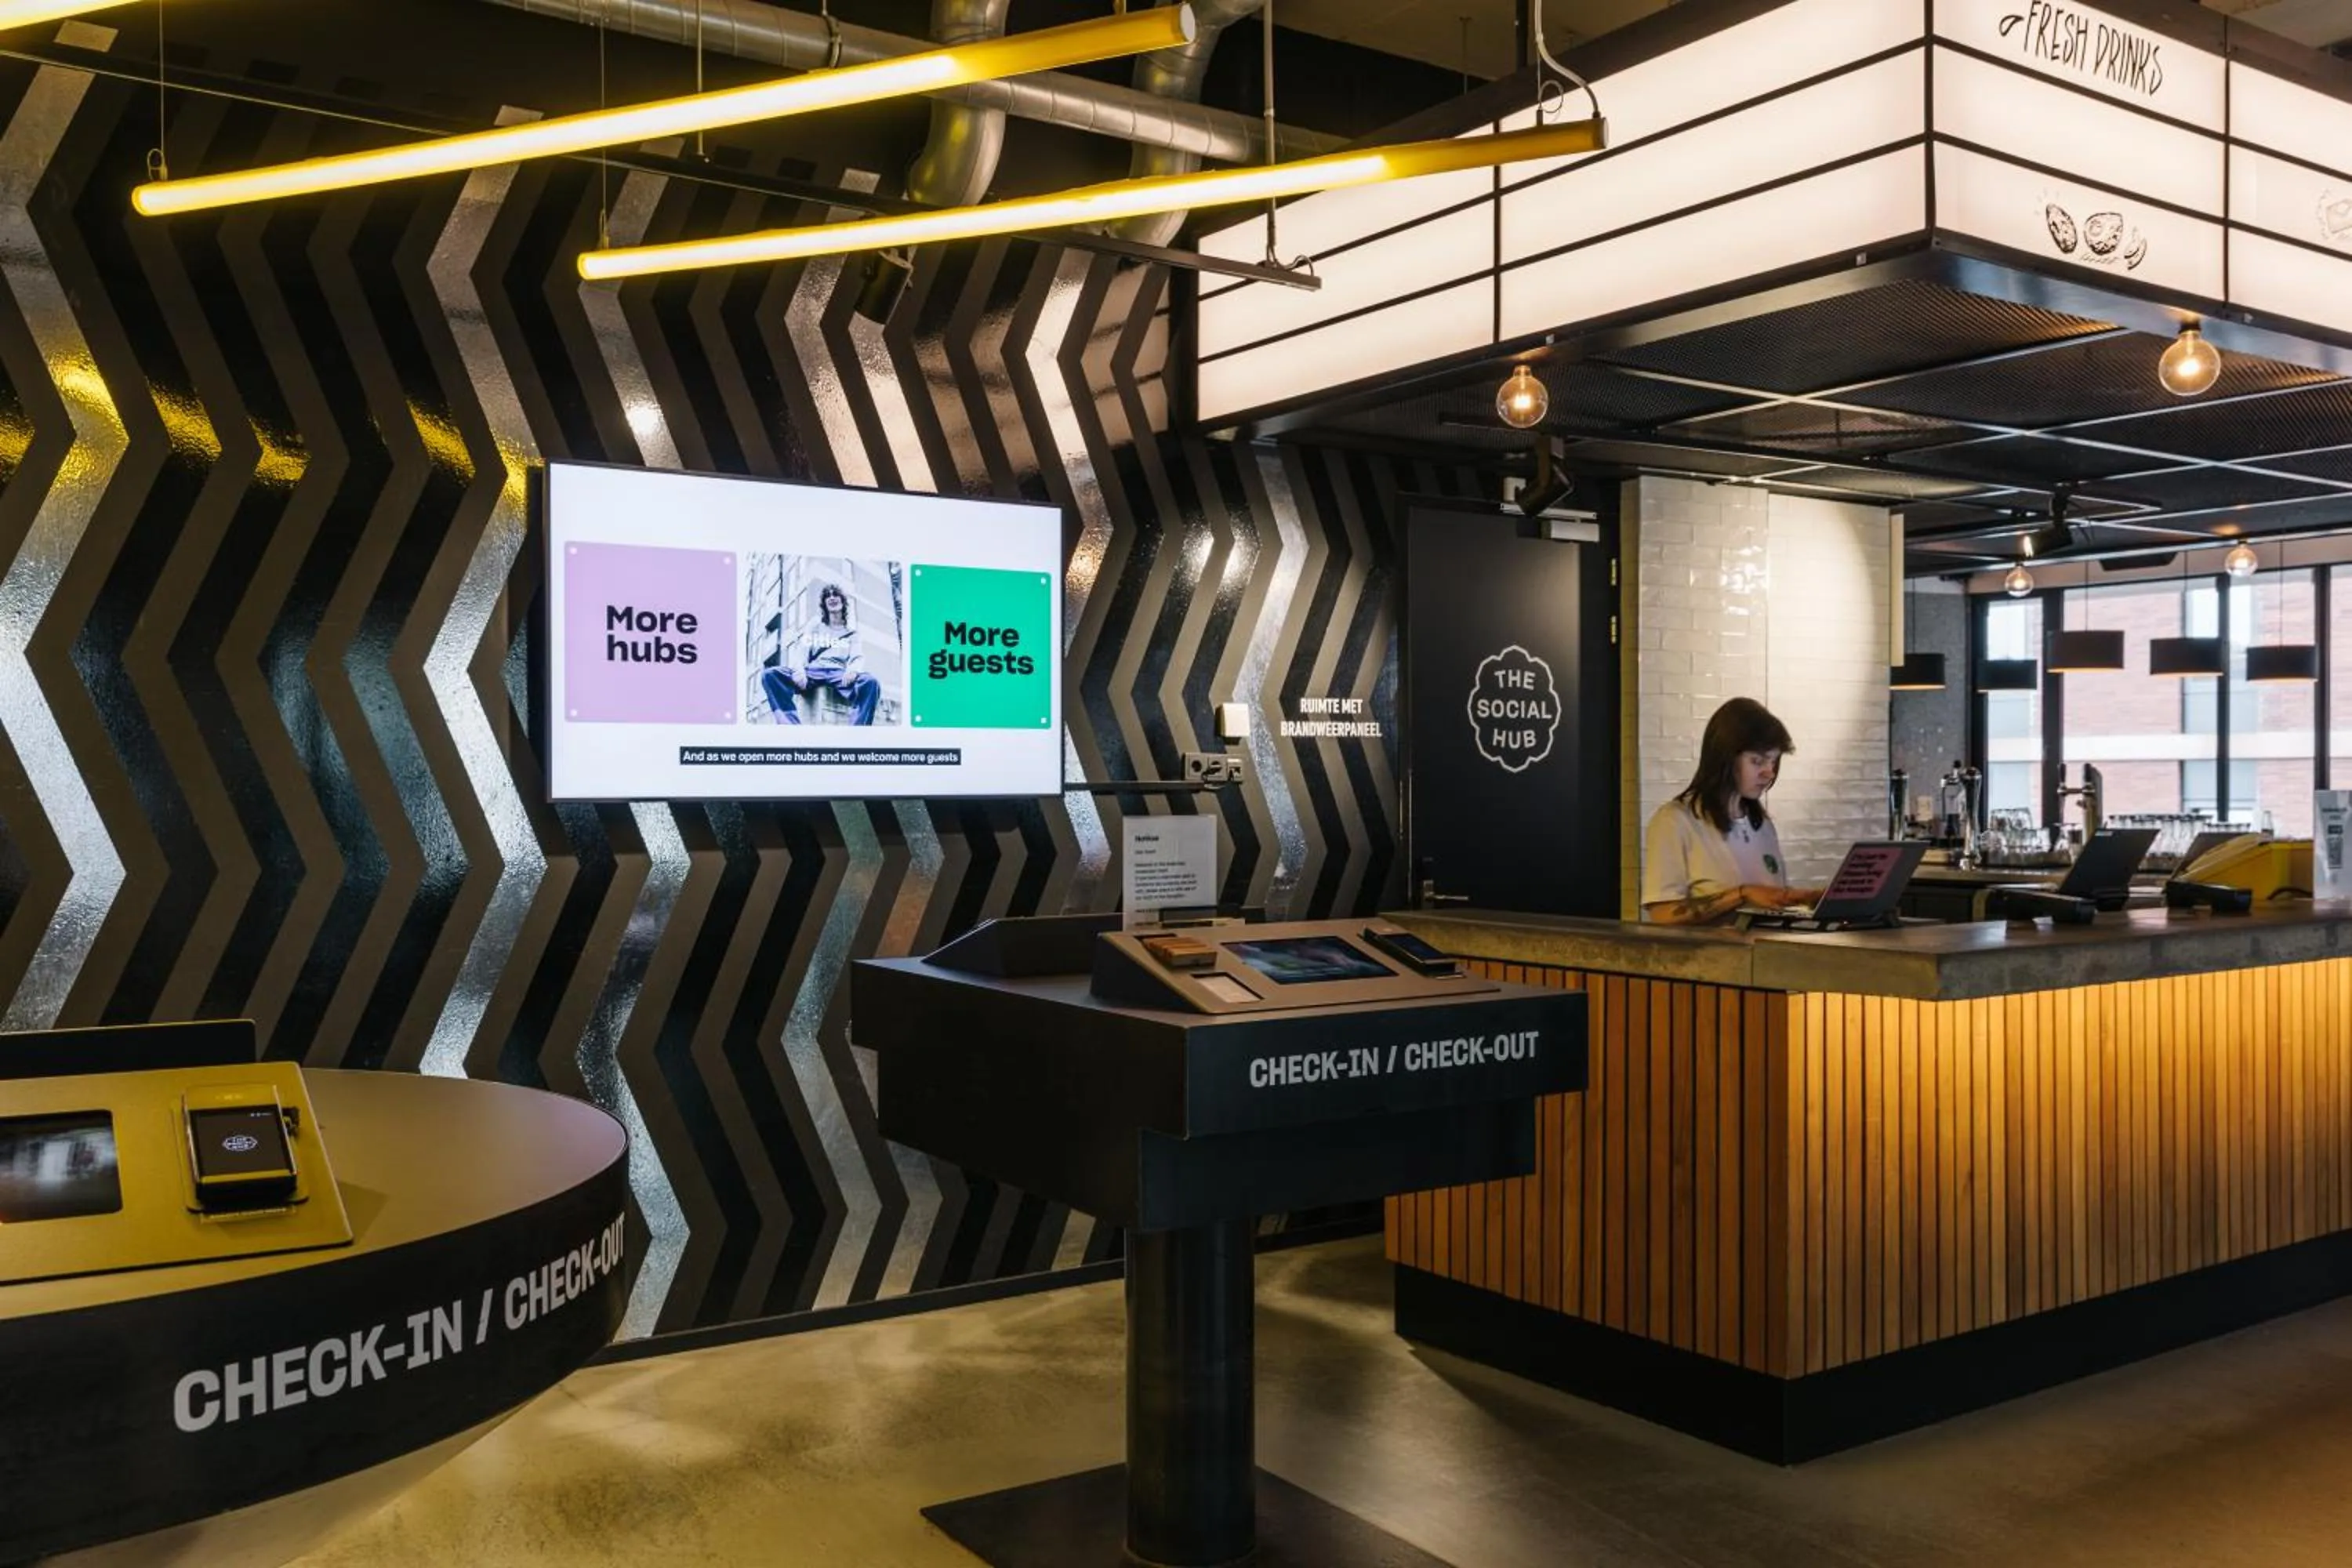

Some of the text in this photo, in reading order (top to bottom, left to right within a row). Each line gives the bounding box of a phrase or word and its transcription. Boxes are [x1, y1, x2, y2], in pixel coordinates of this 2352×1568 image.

[2024, 0, 2164, 96] FRESH DRINKS
[606, 605, 698, 635] More
[945, 621, 1019, 648] More
[607, 633, 698, 664] hubs
[929, 648, 1034, 679] guests
[1494, 669, 1536, 690] THE
[1300, 698, 1363, 714] RUIMTE MET
[1477, 699, 1552, 720] SOCIAL
[1280, 720, 1382, 737] BRANDWEERPANEEL
[1492, 728, 1537, 749] HUB
[683, 750, 704, 761] And
[739, 753, 764, 764] open
[794, 751, 818, 762] hubs
[821, 752, 840, 762] and
[858, 752, 899, 762] welcome
[927, 753, 958, 764] guests
[1249, 1031, 1539, 1087] CHECK-IN / CHECK-OUT
[173, 1211, 626, 1432] CHECK-IN / CHECK-OUT
